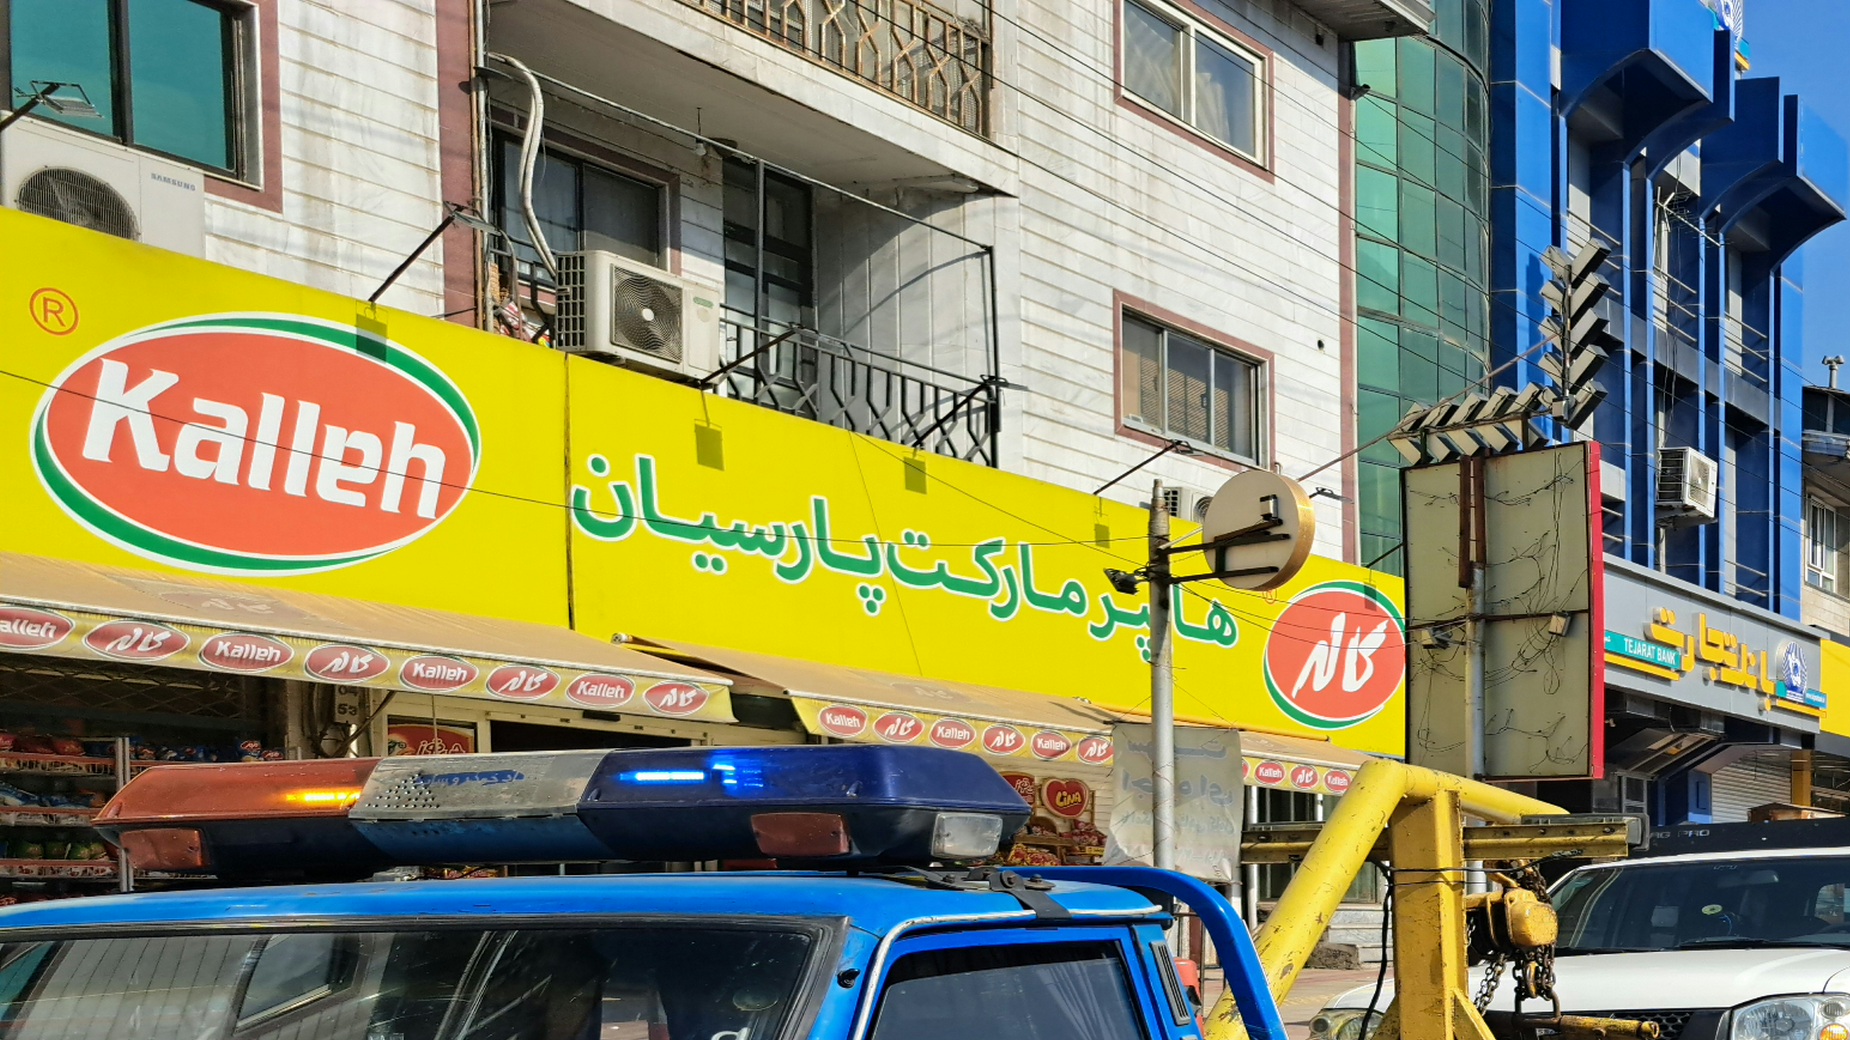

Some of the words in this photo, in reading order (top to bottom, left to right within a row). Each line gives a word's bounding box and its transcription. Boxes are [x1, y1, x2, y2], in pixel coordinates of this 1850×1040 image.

[82, 356, 447, 520] Kalleh
[570, 453, 885, 615] پارسیان
[0, 618, 57, 639] alleh
[214, 640, 282, 664] Kalleh
[1624, 637, 1656, 659] TEJARAT
[1657, 648, 1676, 665] BANK
[412, 662, 468, 683] Kalleh
[577, 679, 626, 700] Kalleh
[825, 712, 861, 729] Kalleh
[936, 724, 971, 741] Kalleh
[1037, 736, 1068, 752] Kalleh
